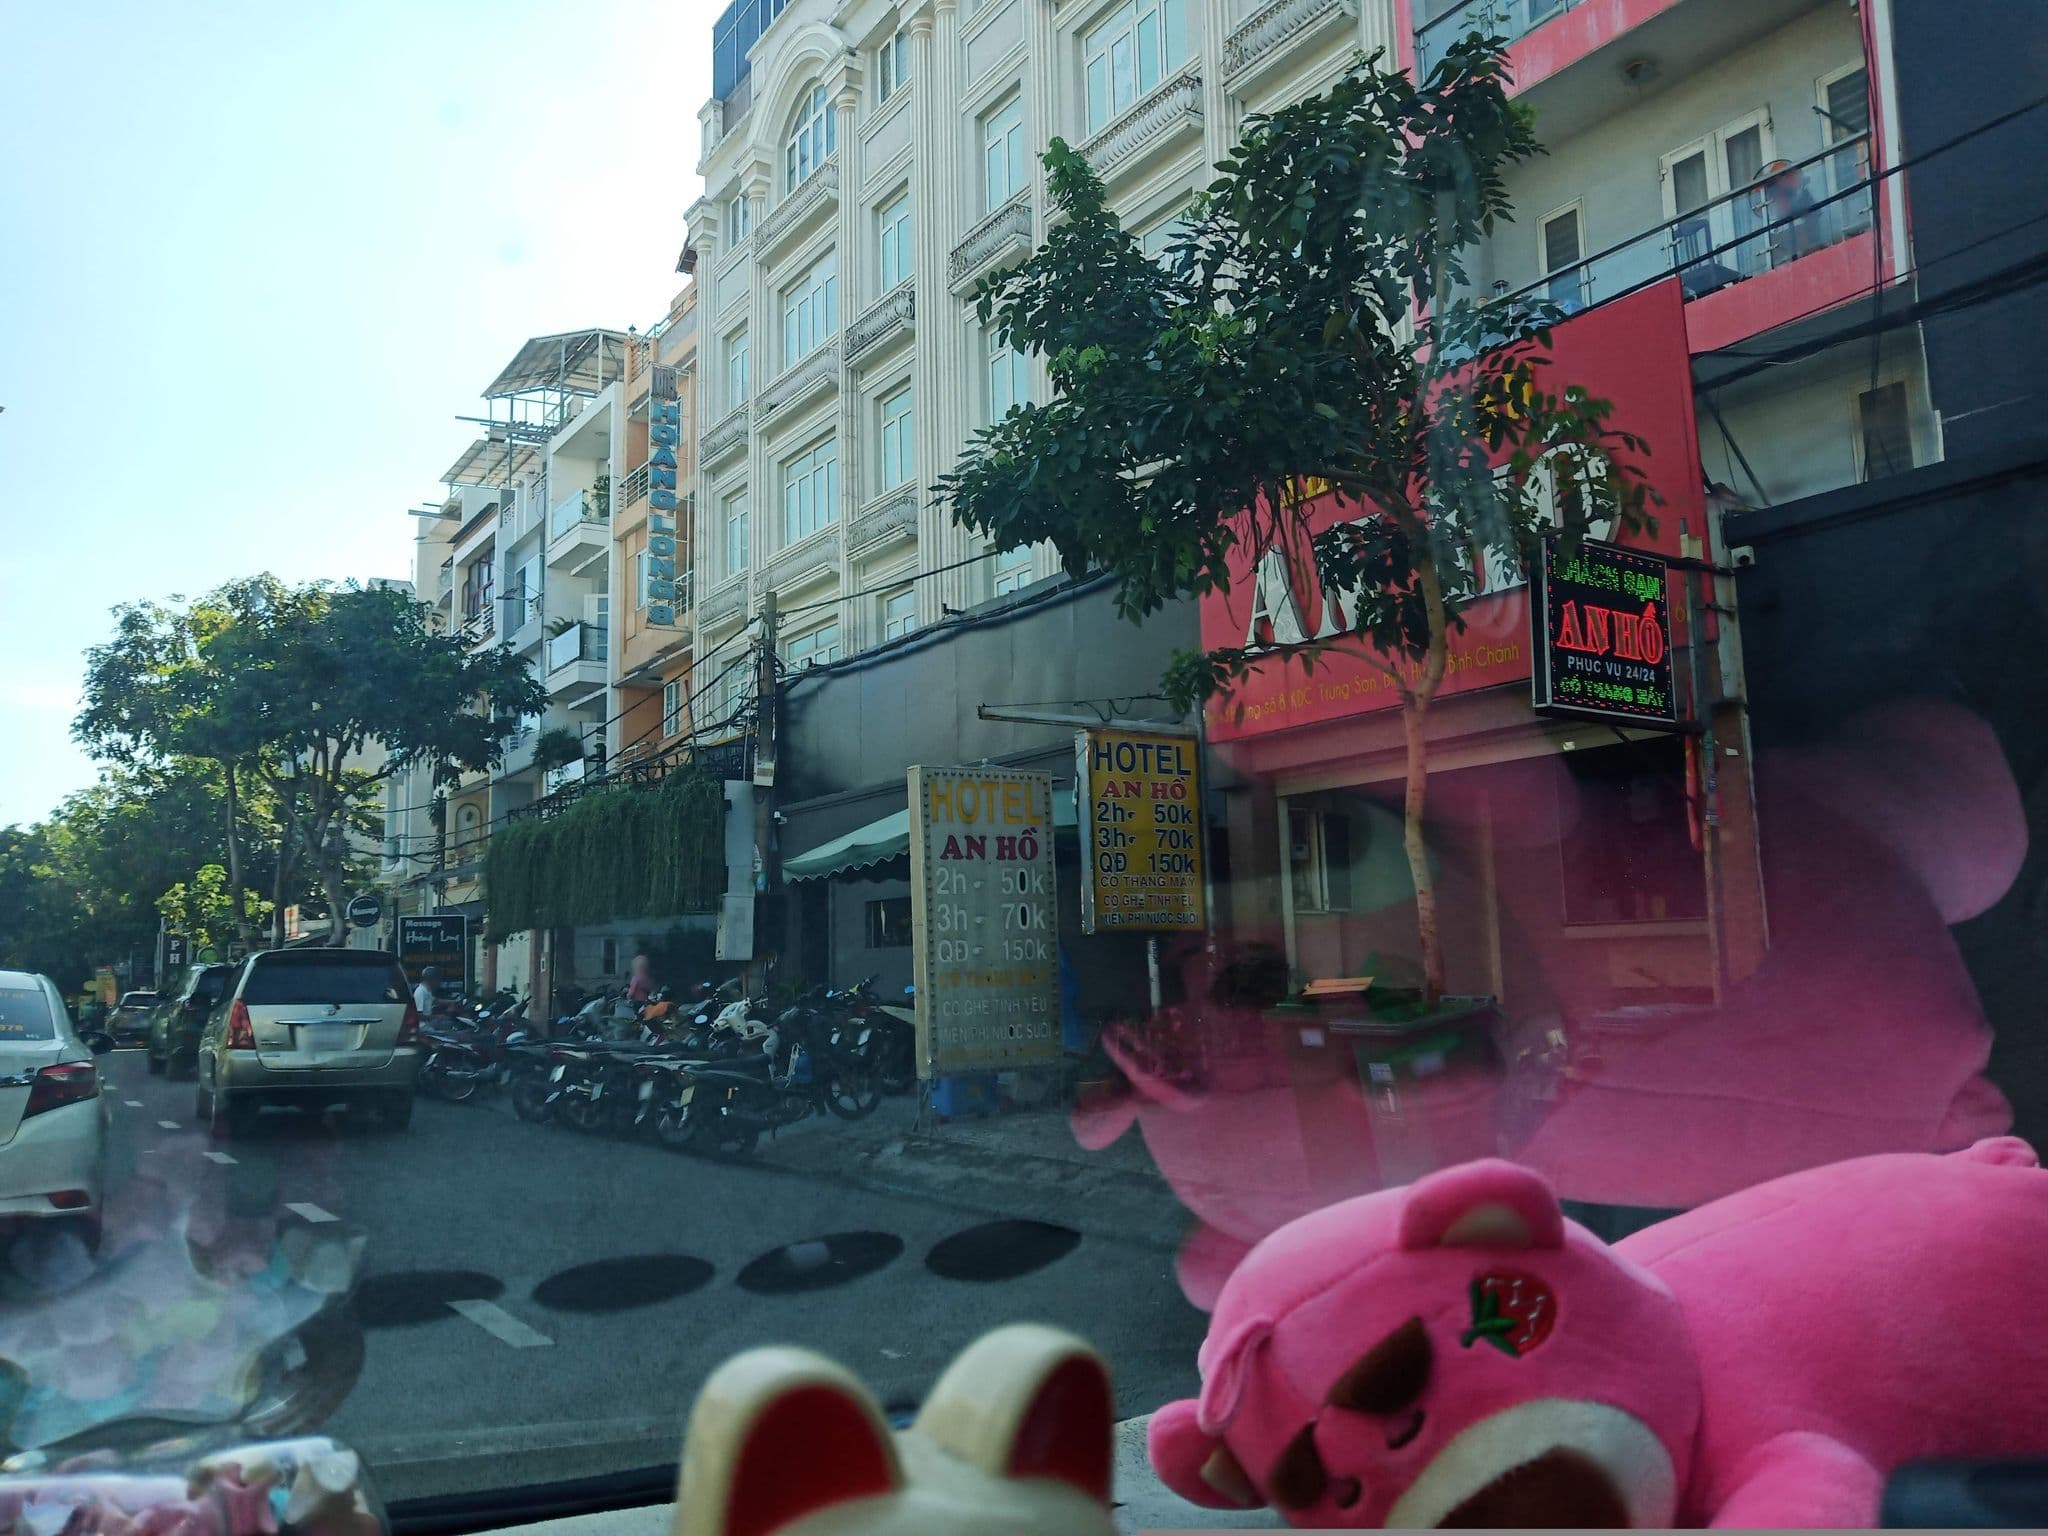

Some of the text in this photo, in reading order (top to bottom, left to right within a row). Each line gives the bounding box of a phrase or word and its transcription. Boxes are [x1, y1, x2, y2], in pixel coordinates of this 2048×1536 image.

[1557, 600, 1611, 656] AN
[1567, 655, 1656, 683] PHỤC VỤ 24/24
[1317, 680, 1350, 704] Trung
[1093, 741, 1192, 776] HOTEL
[1101, 776, 1188, 800] AN HỒ
[931, 779, 1044, 826] HOTEL
[1154, 803, 1193, 824] 50k
[940, 826, 1039, 861] AN HỒ
[1154, 828, 1194, 849] 70k
[1099, 851, 1195, 874] QĐ 150k
[1001, 867, 1045, 895] 50k
[1123, 875, 1167, 888] THANG
[405, 920, 442, 928] Massage
[1001, 902, 1046, 931] 70k
[1002, 938, 1048, 961] 150k
